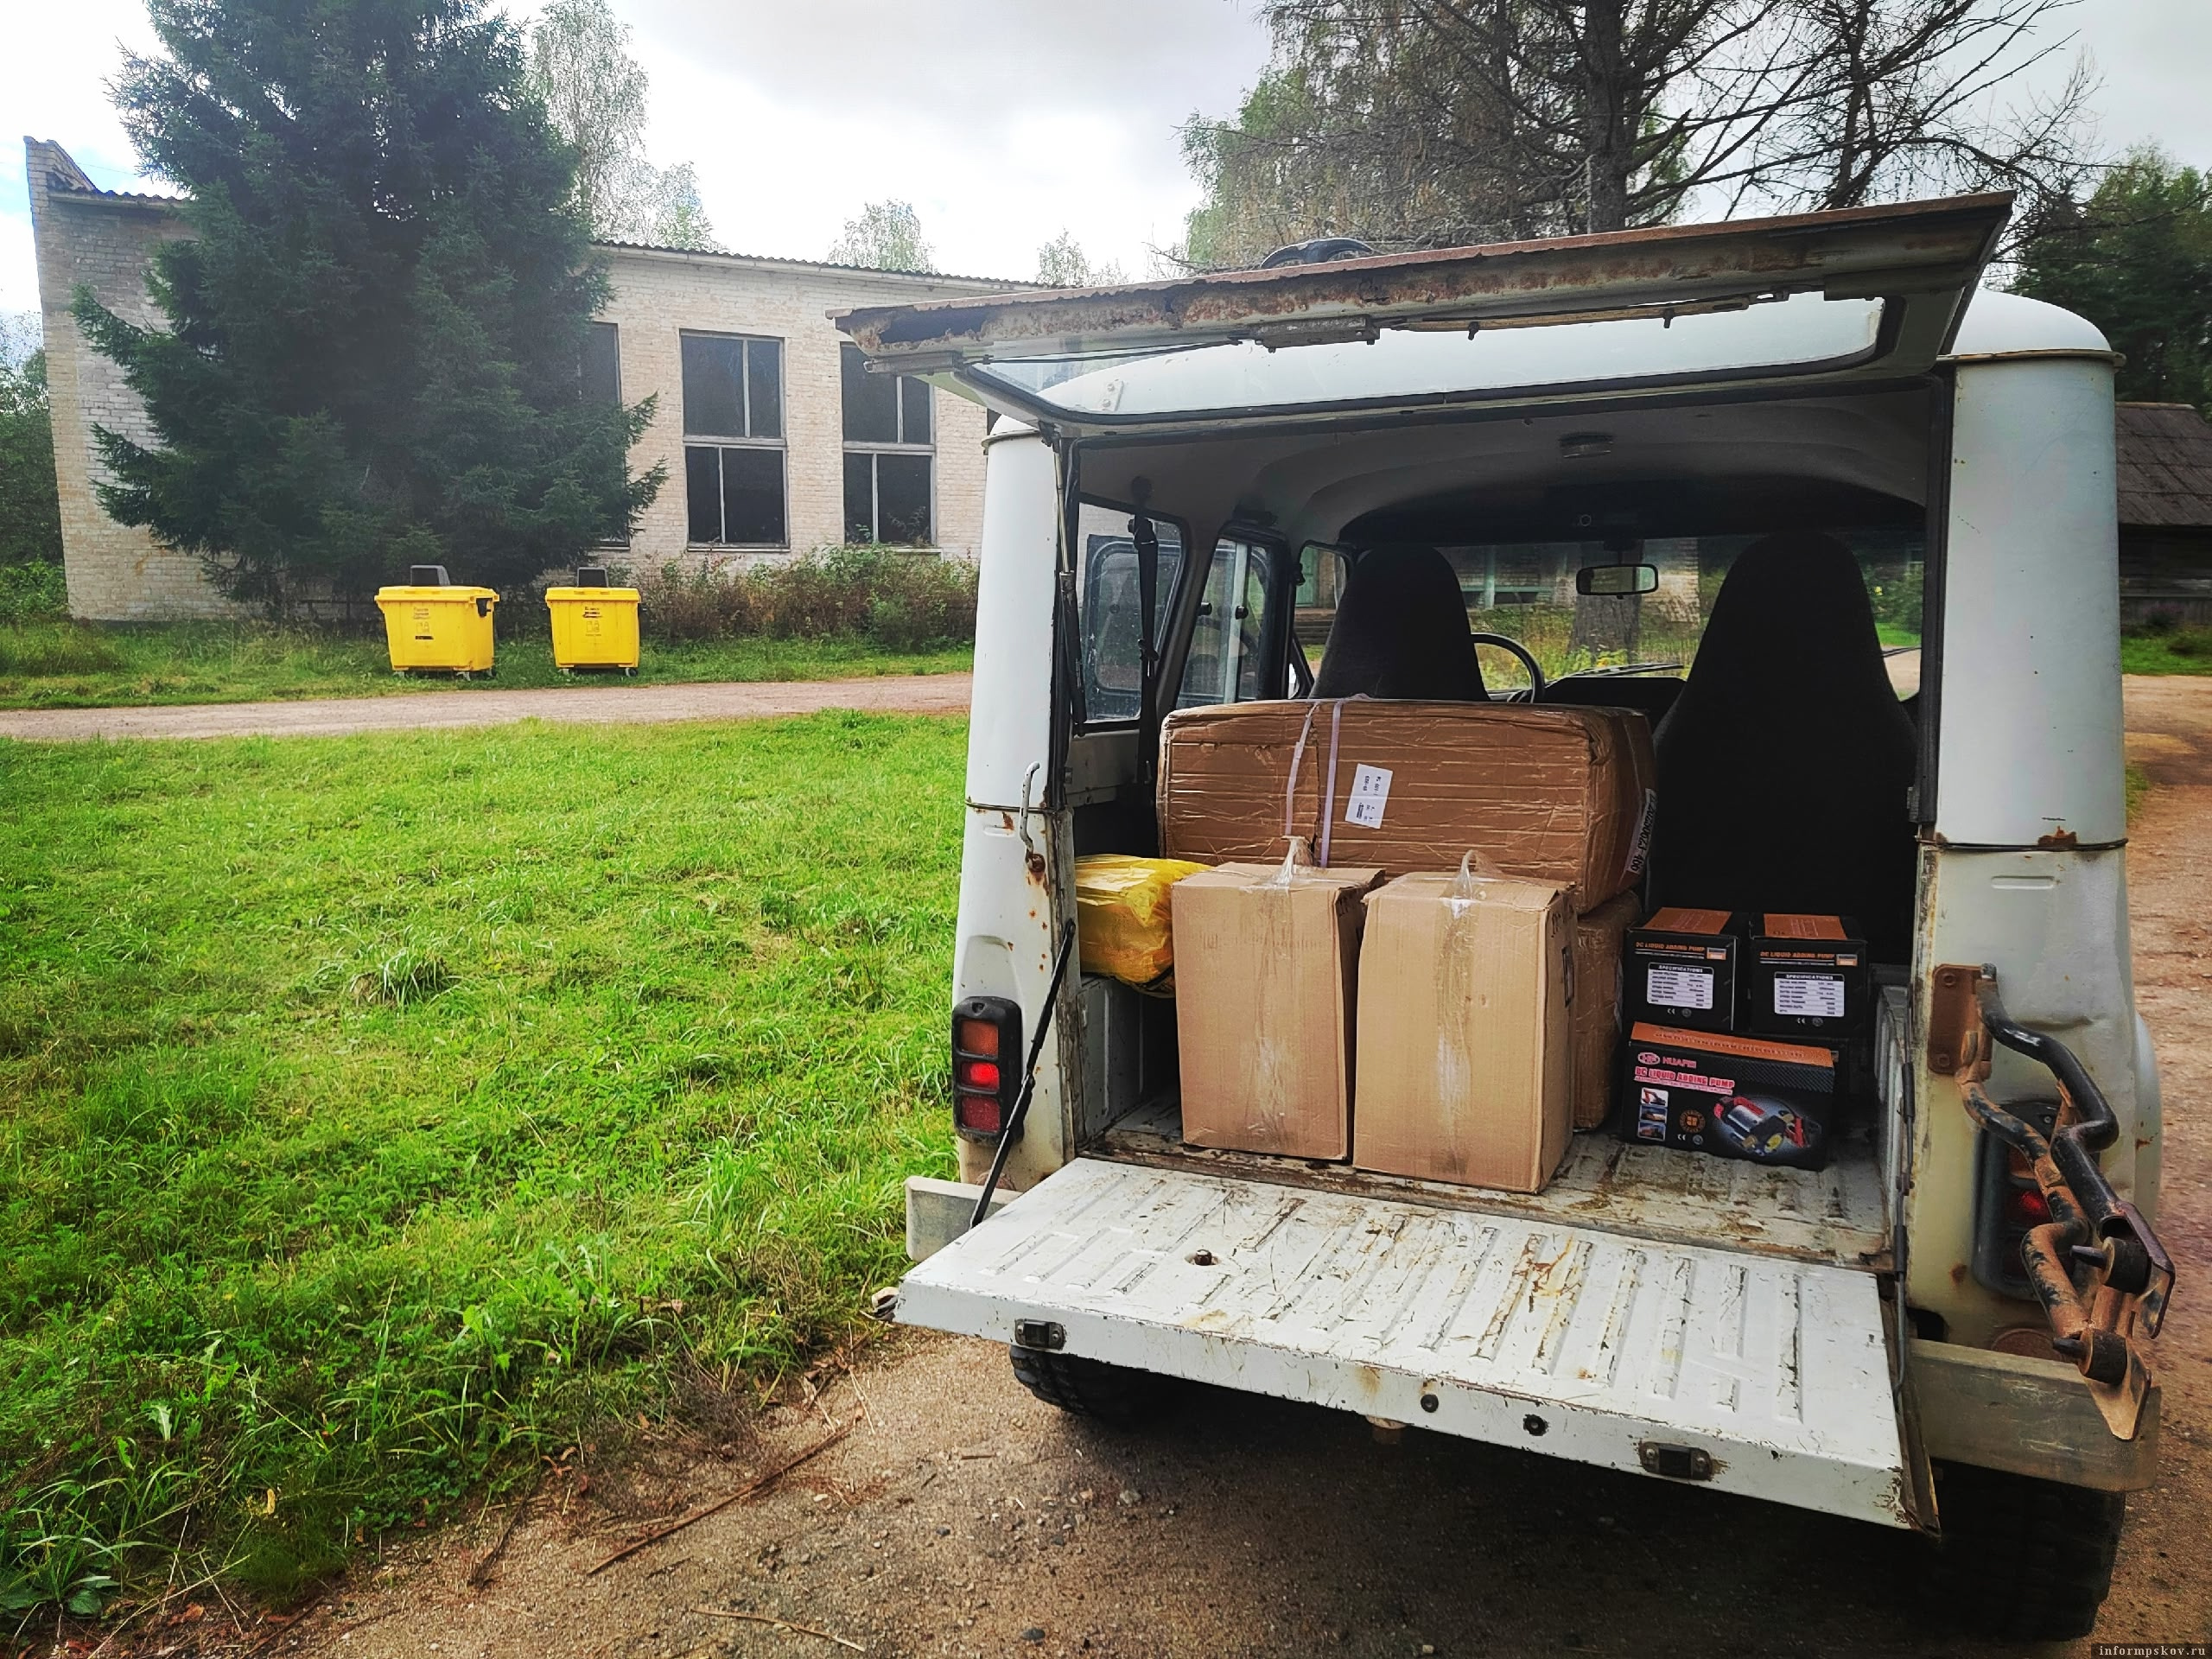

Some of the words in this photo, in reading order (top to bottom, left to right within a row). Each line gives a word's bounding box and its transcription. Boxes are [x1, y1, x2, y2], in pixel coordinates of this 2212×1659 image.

[1658, 964, 1703, 973] SPECIFICATIONS
[1635, 1065, 1648, 1077] DC
[1648, 1068, 1676, 1081] LIQUID
[1676, 1072, 1708, 1086] ADDING
[1709, 1077, 1735, 1089] PUMP
